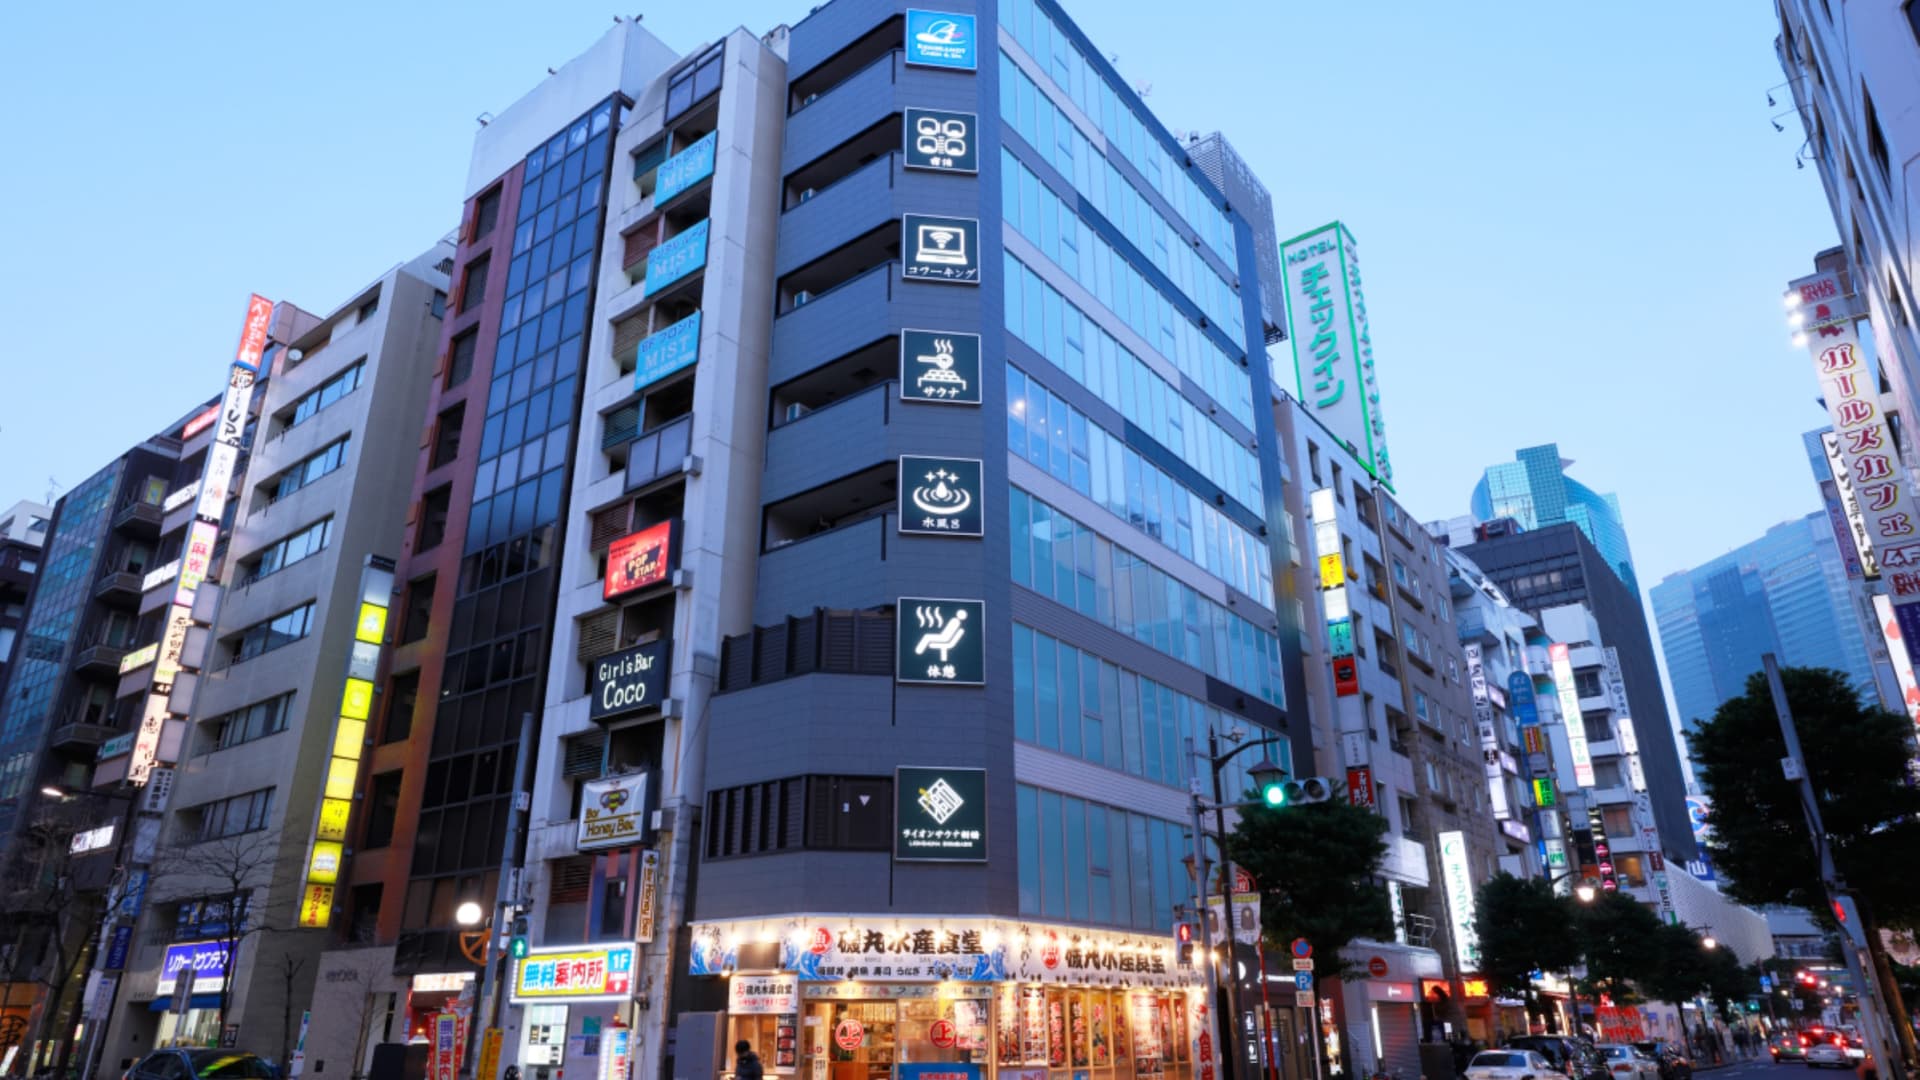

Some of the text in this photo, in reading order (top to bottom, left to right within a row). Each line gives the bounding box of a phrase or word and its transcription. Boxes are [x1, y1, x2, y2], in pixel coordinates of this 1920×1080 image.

[663, 153, 705, 192] MIST
[654, 241, 700, 278] MIST
[1288, 240, 1337, 264] HOTEL
[908, 266, 977, 279] コワーキング
[1300, 261, 1345, 409] チェックイン
[645, 333, 692, 371] MIST
[923, 386, 960, 399] サウナ
[1819, 342, 1914, 538] ガールズカフェ
[922, 516, 961, 530] 水風呂
[627, 553, 649, 573] POP
[633, 560, 658, 578] STAR
[634, 652, 655, 673] Bar
[603, 680, 646, 710] Coco
[586, 807, 600, 820] Bar
[587, 817, 635, 838] Honey Bee
[612, 951, 629, 970] 1F
[523, 959, 604, 988] 無料案内所
[896, 966, 921, 977] うなぎ
